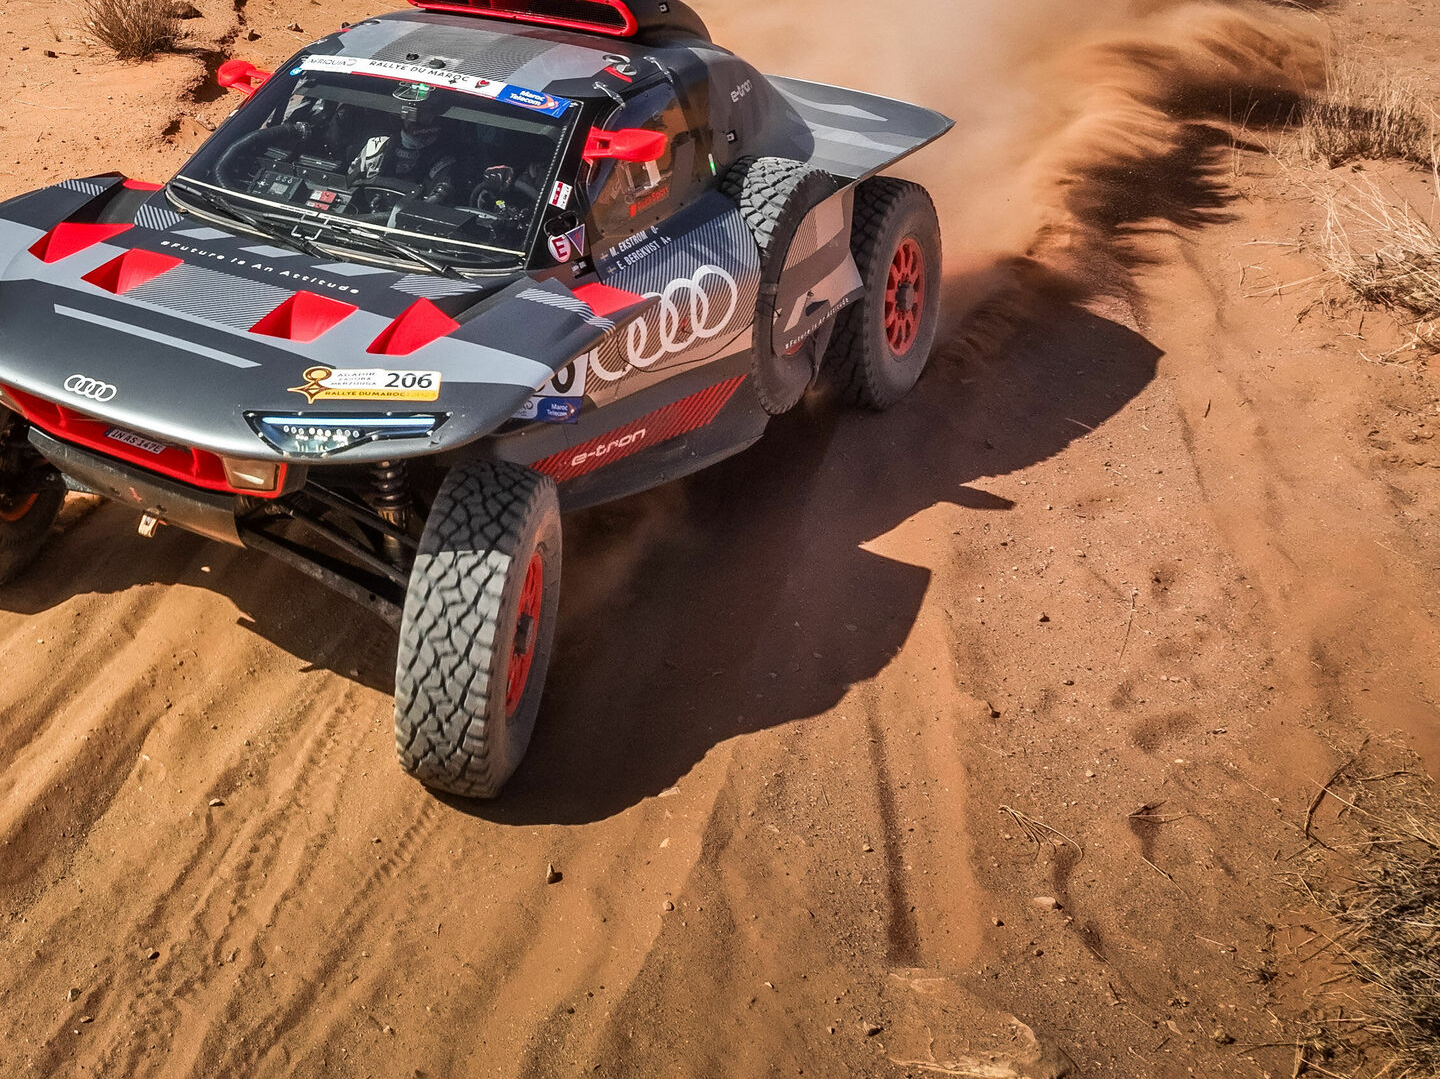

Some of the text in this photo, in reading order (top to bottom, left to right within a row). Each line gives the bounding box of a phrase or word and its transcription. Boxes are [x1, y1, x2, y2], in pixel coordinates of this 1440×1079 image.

[369, 60, 470, 82] RALLYE DU MAROC
[509, 93, 542, 106] Telecom
[519, 90, 546, 102] Maroc
[552, 237, 568, 258] E
[609, 246, 620, 258] M.
[616, 236, 672, 270] E. BERGKVIST A+
[160, 240, 224, 260] #Future
[251, 262, 274, 272] An
[279, 270, 360, 294] Attitude
[383, 372, 433, 388] 206
[546, 409, 568, 417] Telecom
[551, 403, 569, 411] Maroc
[124, 434, 137, 443] AS
[571, 428, 646, 467] e-tron
